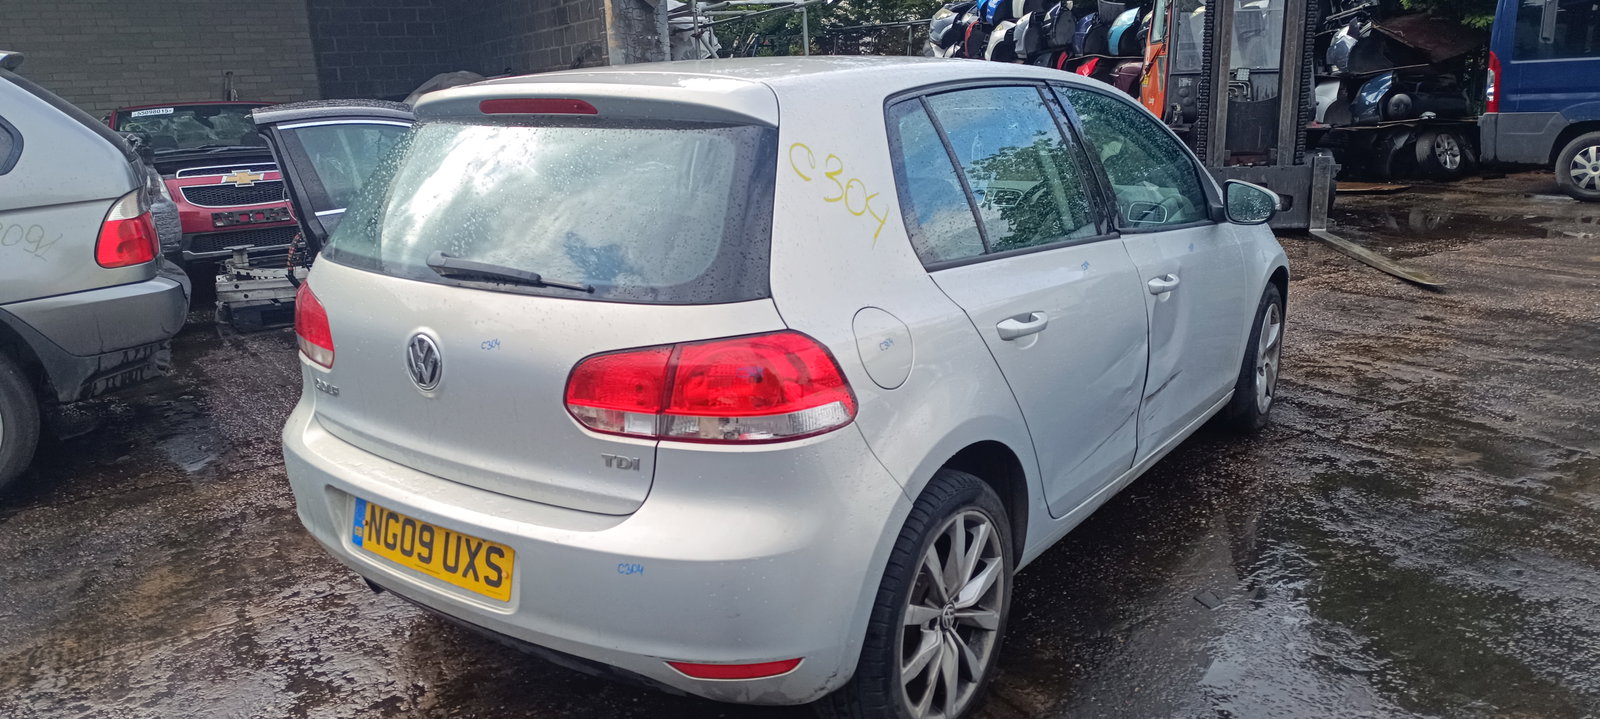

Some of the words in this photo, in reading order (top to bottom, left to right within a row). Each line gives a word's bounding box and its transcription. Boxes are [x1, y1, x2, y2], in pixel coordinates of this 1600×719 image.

[0, 222, 63, 261] 091
[601, 453, 640, 472] TDI
[367, 503, 435, 565] NG09
[442, 532, 505, 588] UXS
